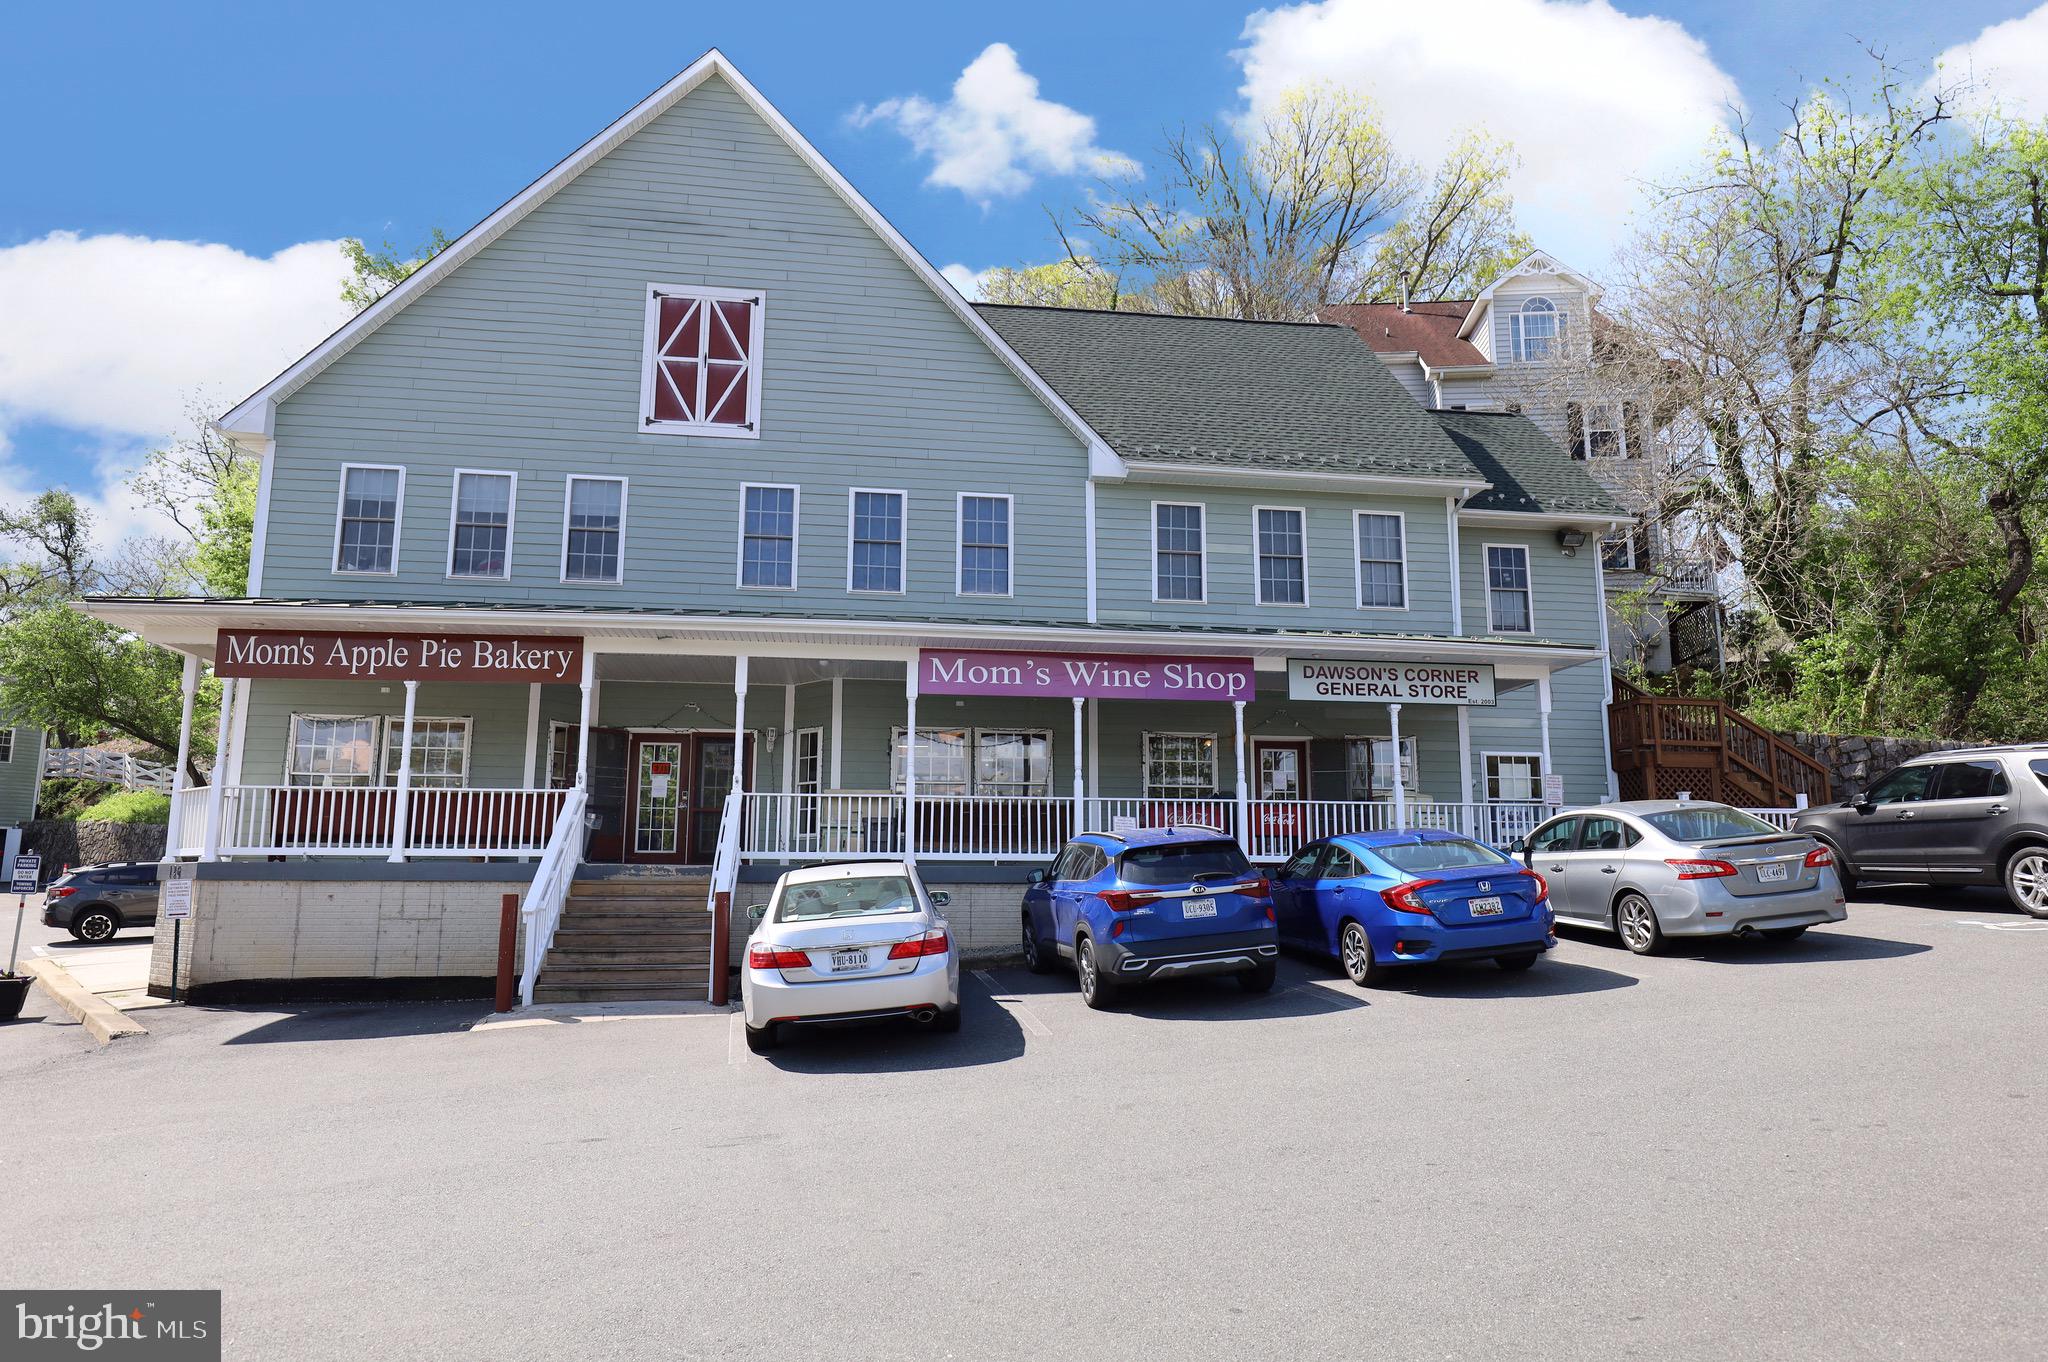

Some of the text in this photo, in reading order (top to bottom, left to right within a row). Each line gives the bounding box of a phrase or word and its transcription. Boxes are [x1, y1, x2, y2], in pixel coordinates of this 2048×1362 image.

[225, 635, 574, 678] Mom's Apple Pie Bakery
[928, 657, 1246, 696] Mom's Wine Shop
[1303, 665, 1480, 684] DAWSON'S CORNER
[1316, 682, 1468, 699] GENERAL STORE
